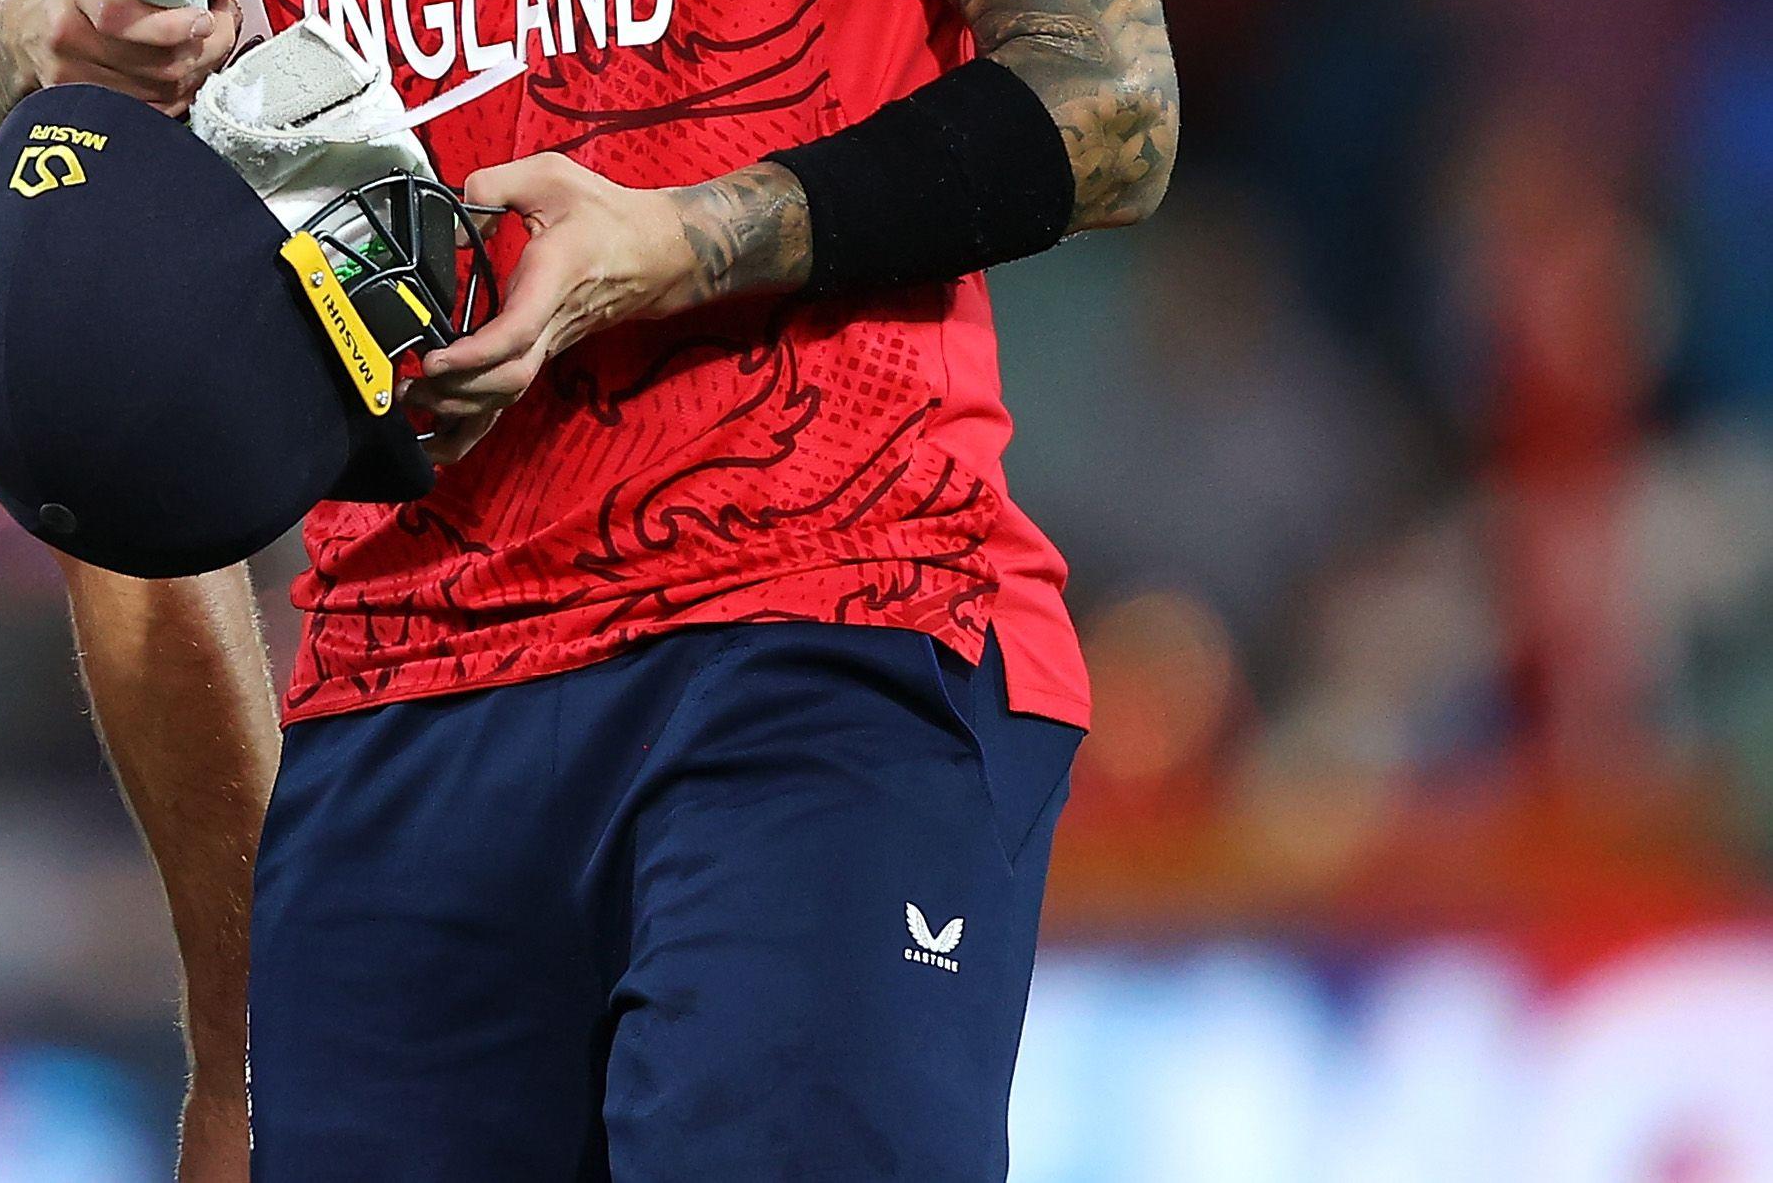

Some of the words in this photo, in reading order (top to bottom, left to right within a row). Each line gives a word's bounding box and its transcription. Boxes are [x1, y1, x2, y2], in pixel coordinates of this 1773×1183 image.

[29, 124, 108, 151] MASURI
[322, 293, 374, 384] MASURI
[904, 948, 959, 973] CASTORE
